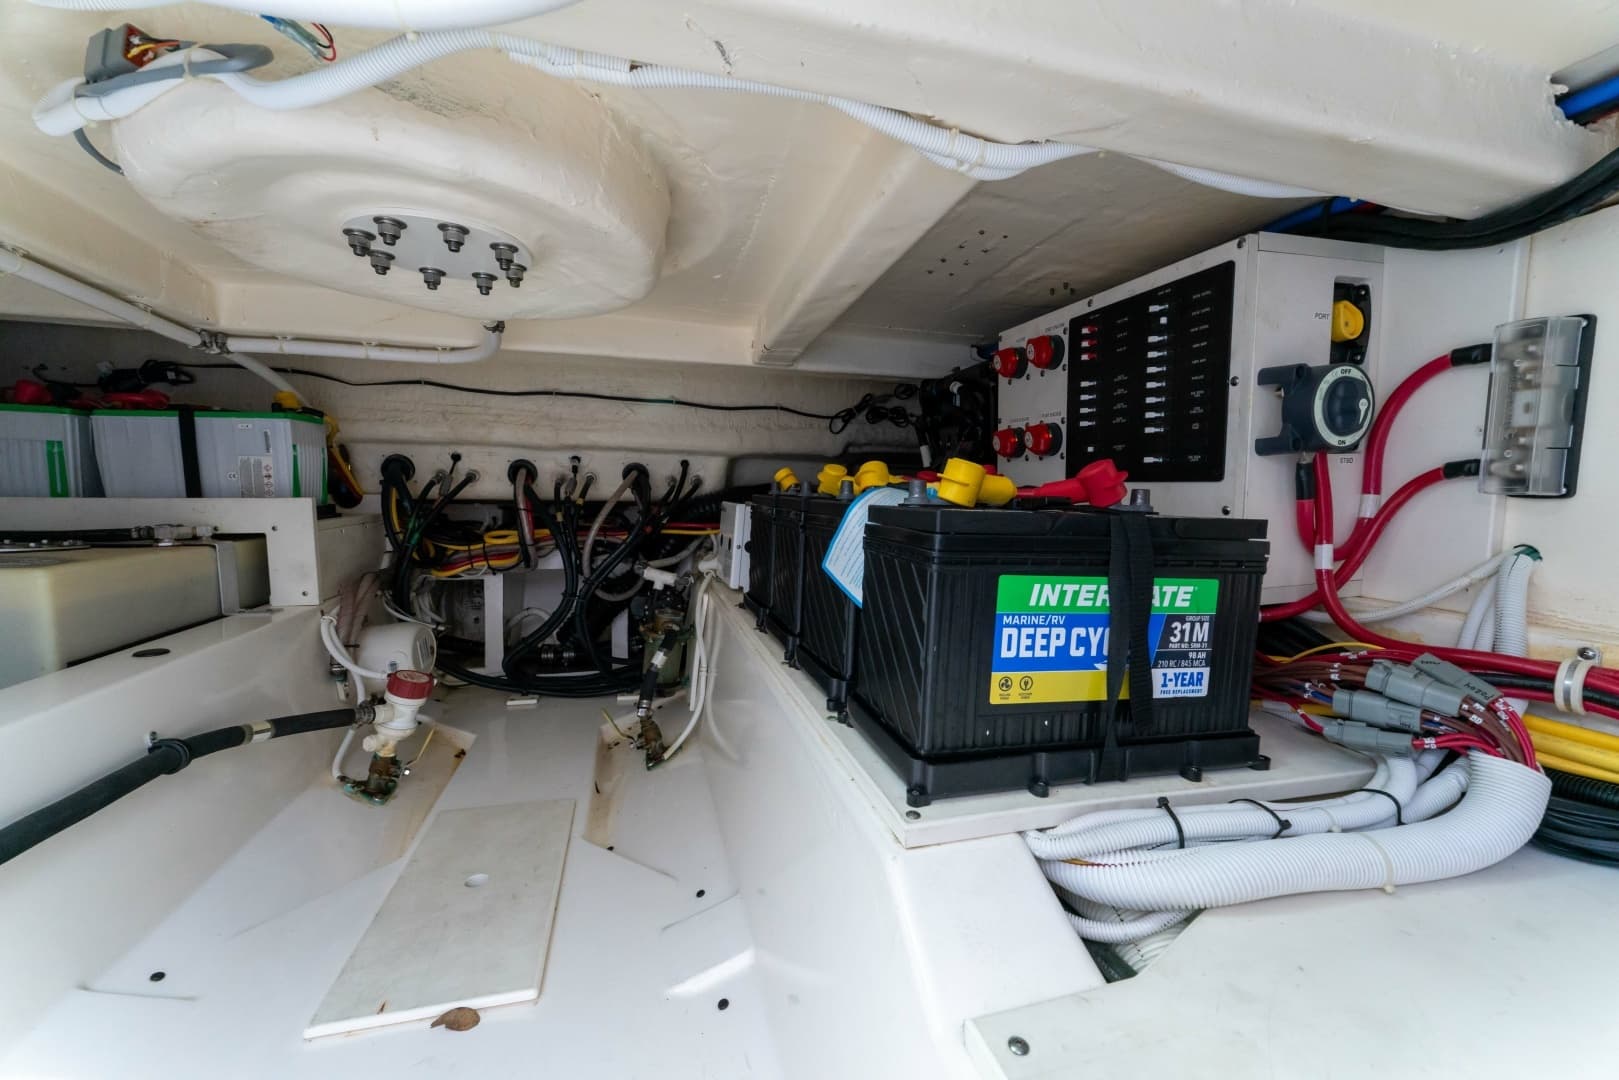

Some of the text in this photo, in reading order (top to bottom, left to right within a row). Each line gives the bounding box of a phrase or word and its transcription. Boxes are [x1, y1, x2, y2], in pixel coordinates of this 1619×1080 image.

[1029, 584, 1193, 607] INTERATE
[1003, 615, 1065, 626] MARINE/RV
[1170, 622, 1209, 642] 31M
[1001, 627, 1066, 658] DEEP
[1161, 672, 1204, 688] 1-YEAR
